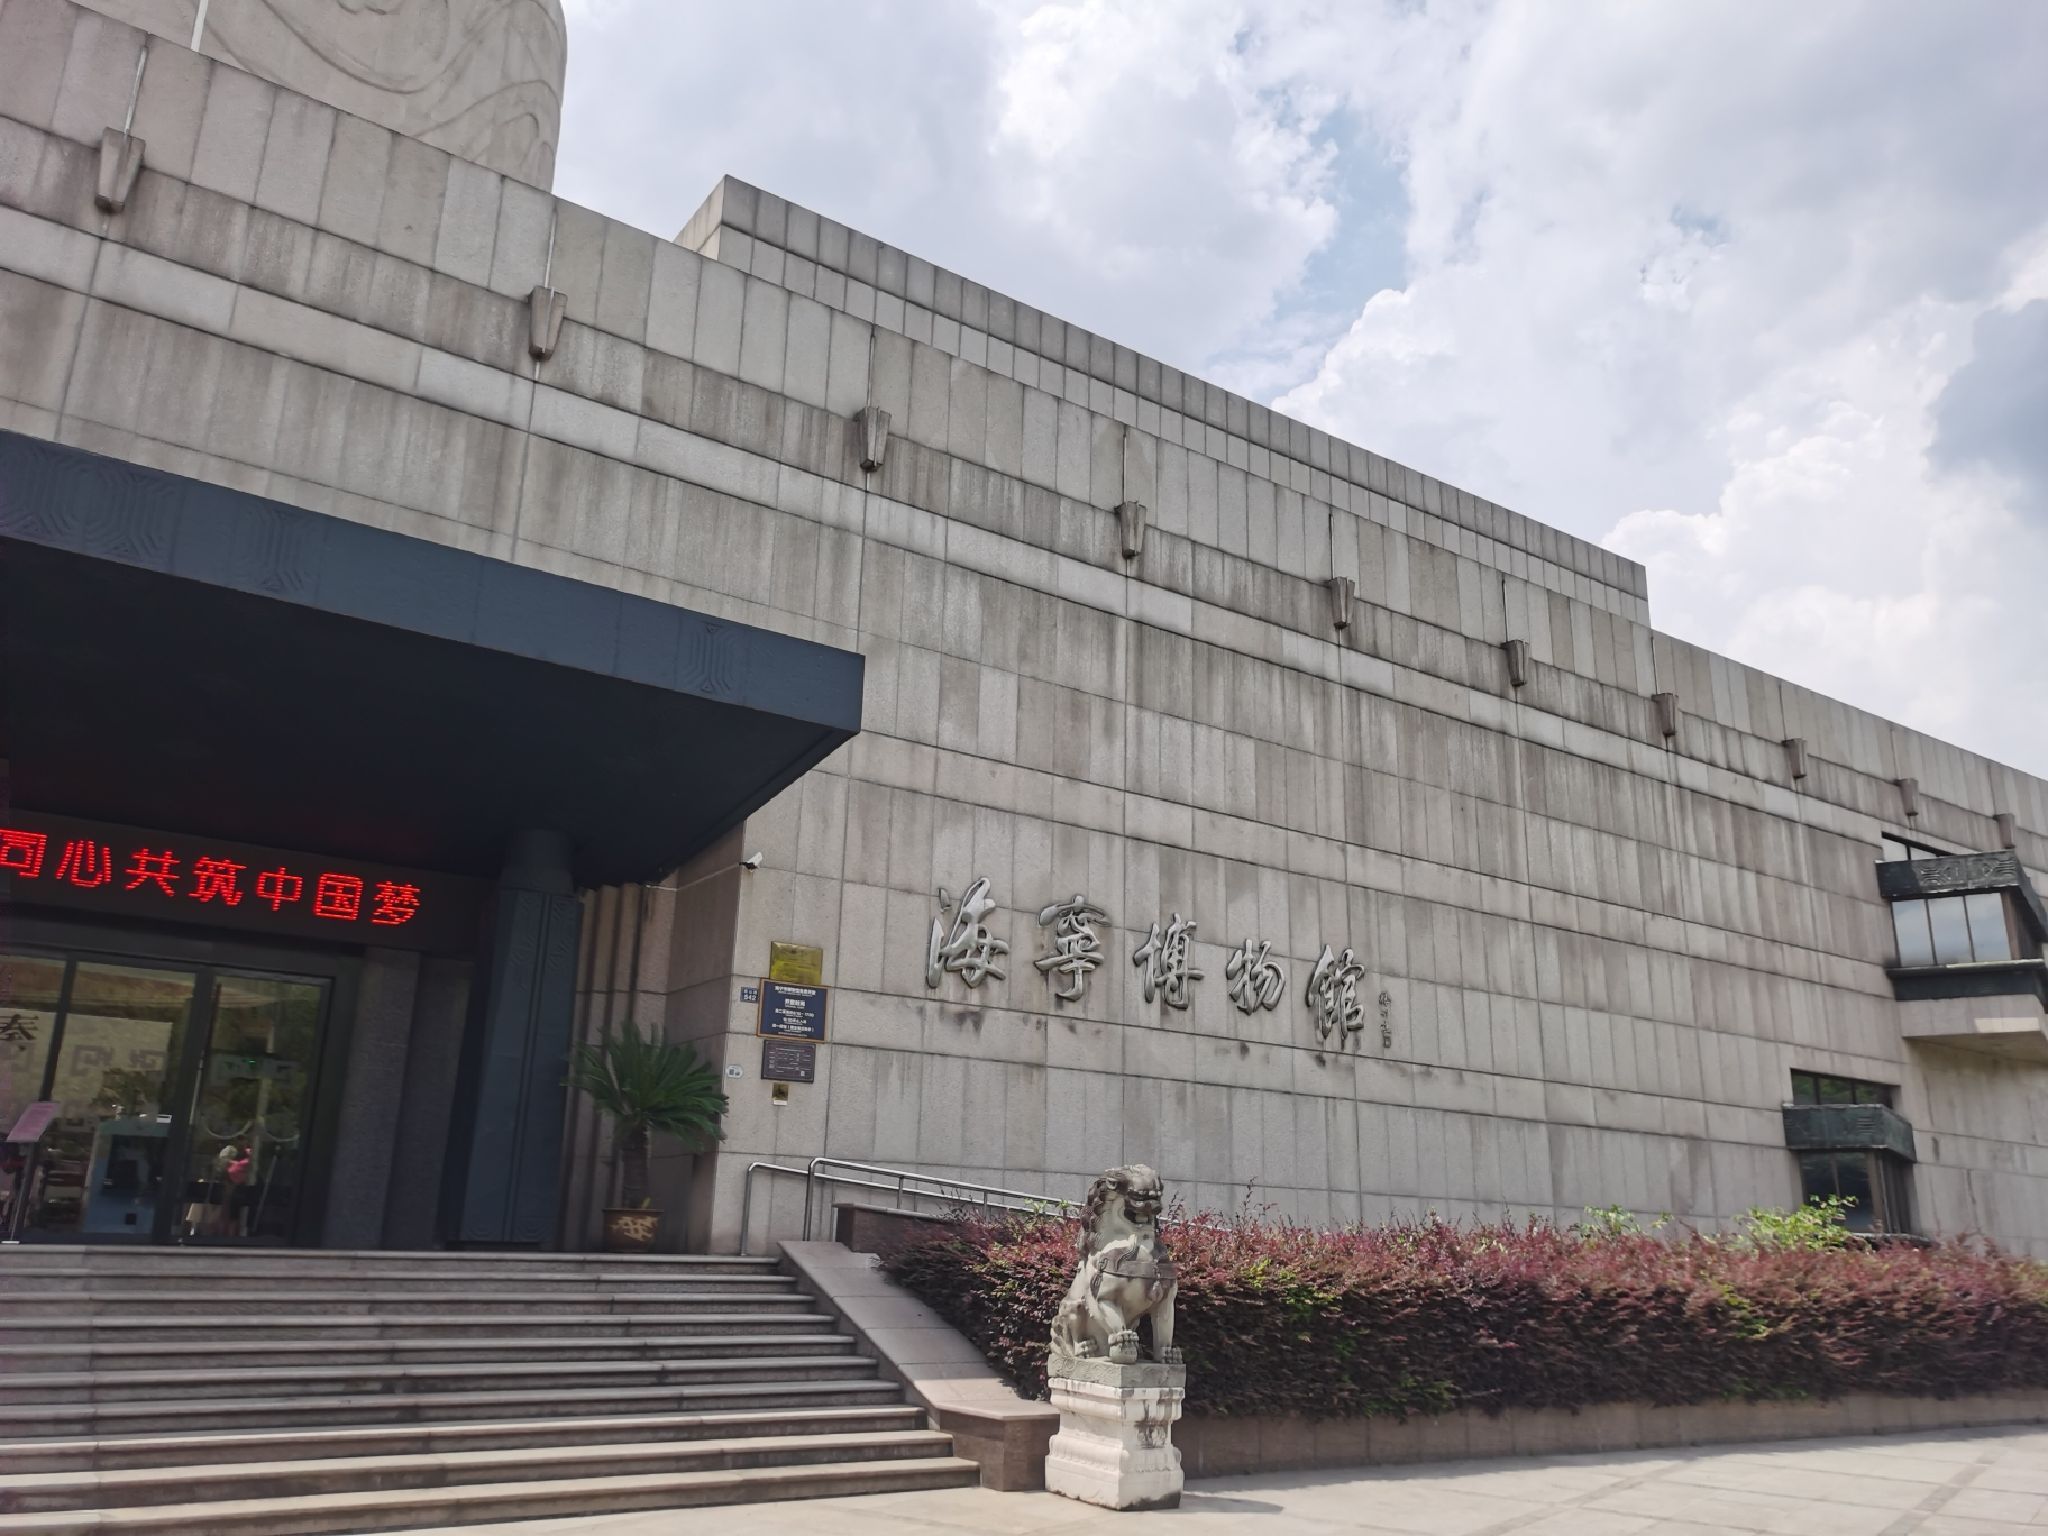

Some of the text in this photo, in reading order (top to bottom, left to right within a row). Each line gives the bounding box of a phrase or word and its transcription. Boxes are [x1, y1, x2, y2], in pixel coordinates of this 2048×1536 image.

[0, 829, 422, 925] 同心共筑中国梦
